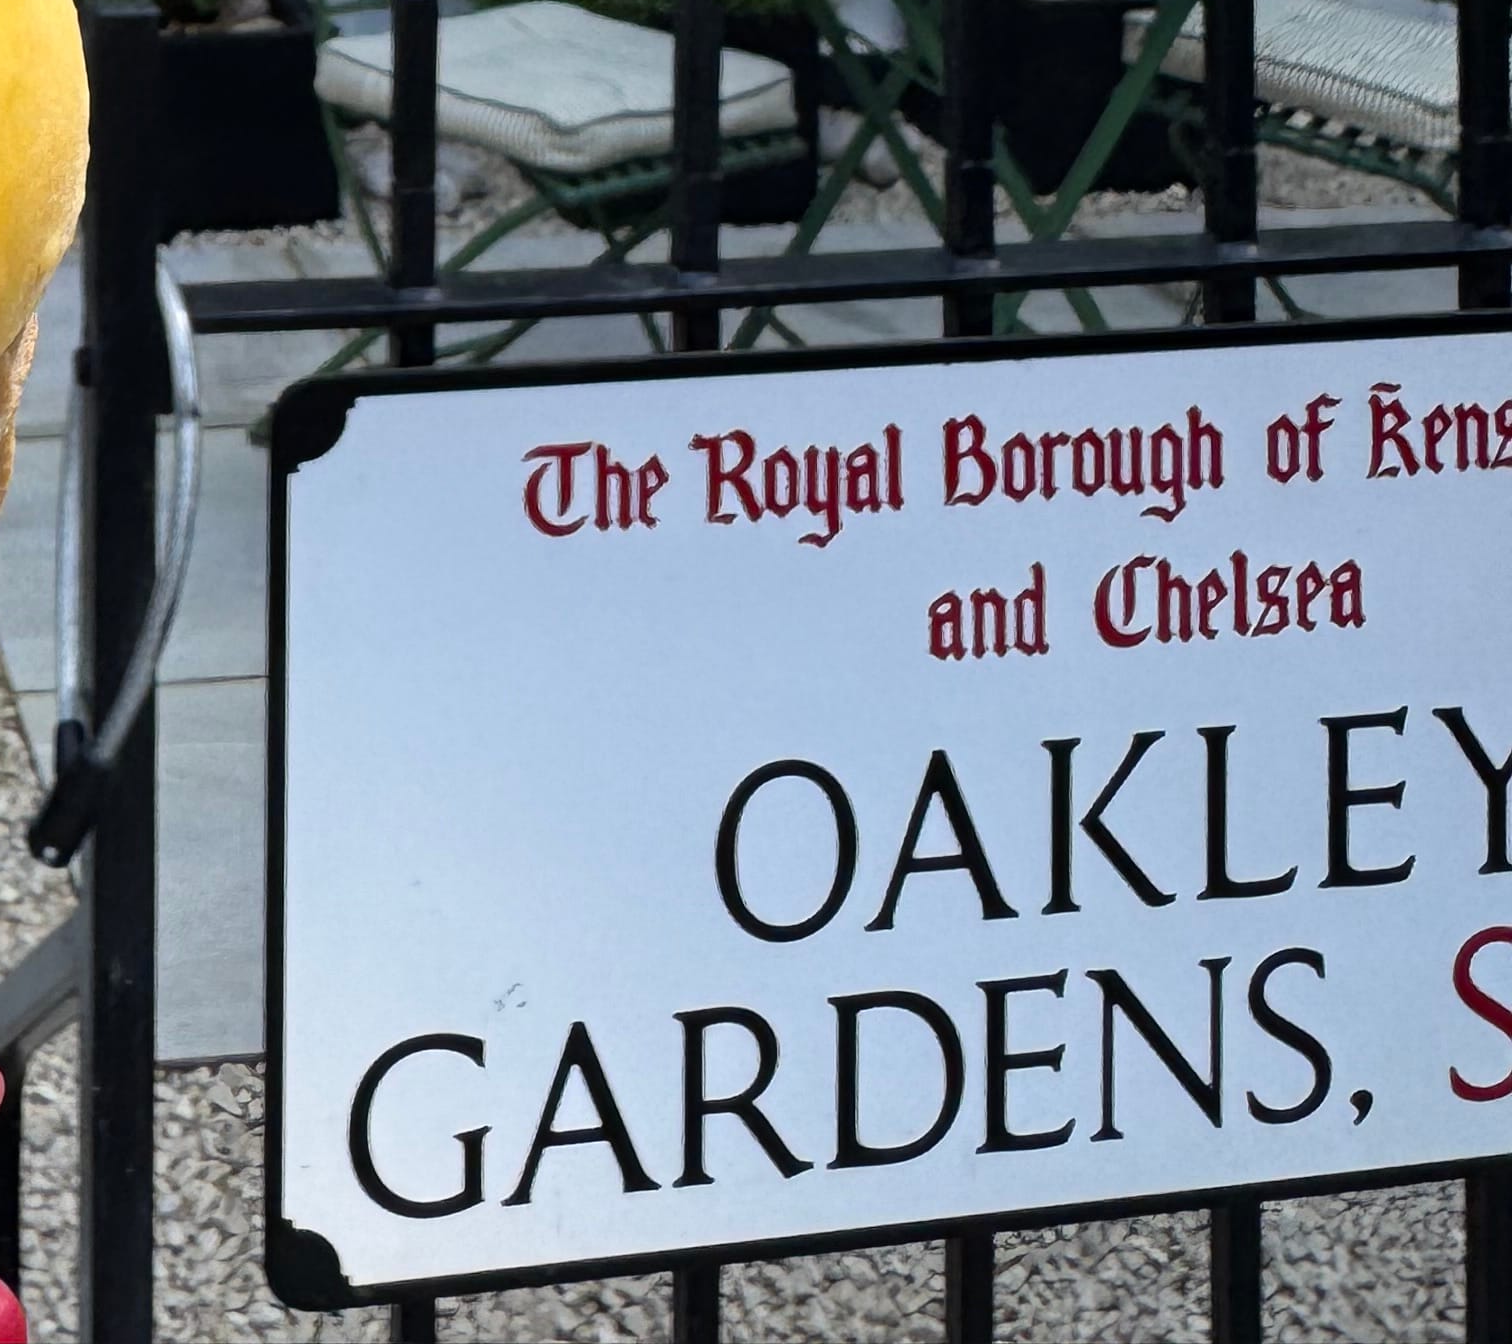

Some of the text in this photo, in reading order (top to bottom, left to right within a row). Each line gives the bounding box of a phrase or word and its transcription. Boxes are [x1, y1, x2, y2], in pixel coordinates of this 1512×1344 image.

[522, 440, 669, 537] The
[689, 424, 904, 547] Royal
[942, 405, 1224, 522] Borough
[1265, 394, 1342, 484] of
[928, 550, 1366, 661] and Chelsea
[714, 705, 1512, 943] OAKLEY
[346, 947, 1376, 1220] GARDENS,
